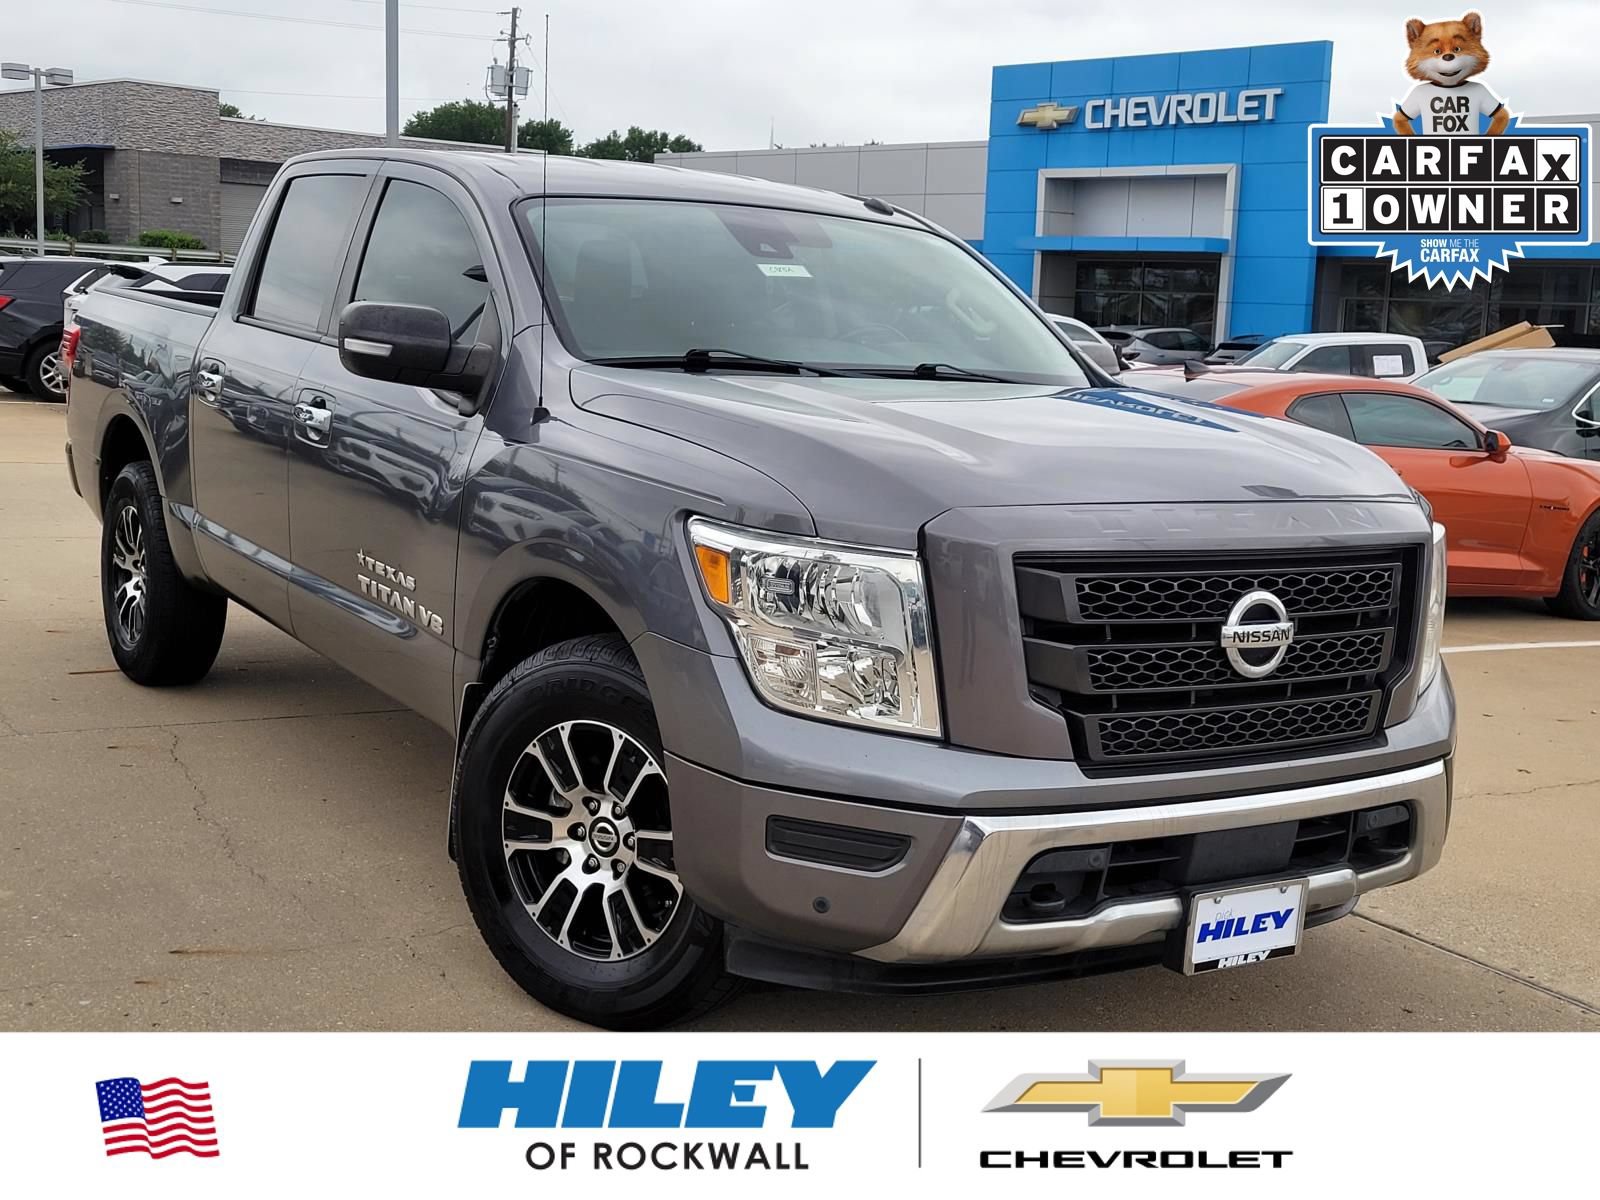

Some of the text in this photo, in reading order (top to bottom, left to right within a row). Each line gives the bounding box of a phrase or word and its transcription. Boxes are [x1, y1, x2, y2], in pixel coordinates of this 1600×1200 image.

[1085, 87, 1283, 129] CHEVROLET
[1064, 508, 1384, 532] TITAN
[365, 556, 416, 591] TEXAS
[357, 574, 443, 635] TITAN V8
[1232, 629, 1290, 643] NISSAN
[1197, 908, 1295, 944] HILEY
[1218, 949, 1272, 968] HILEY
